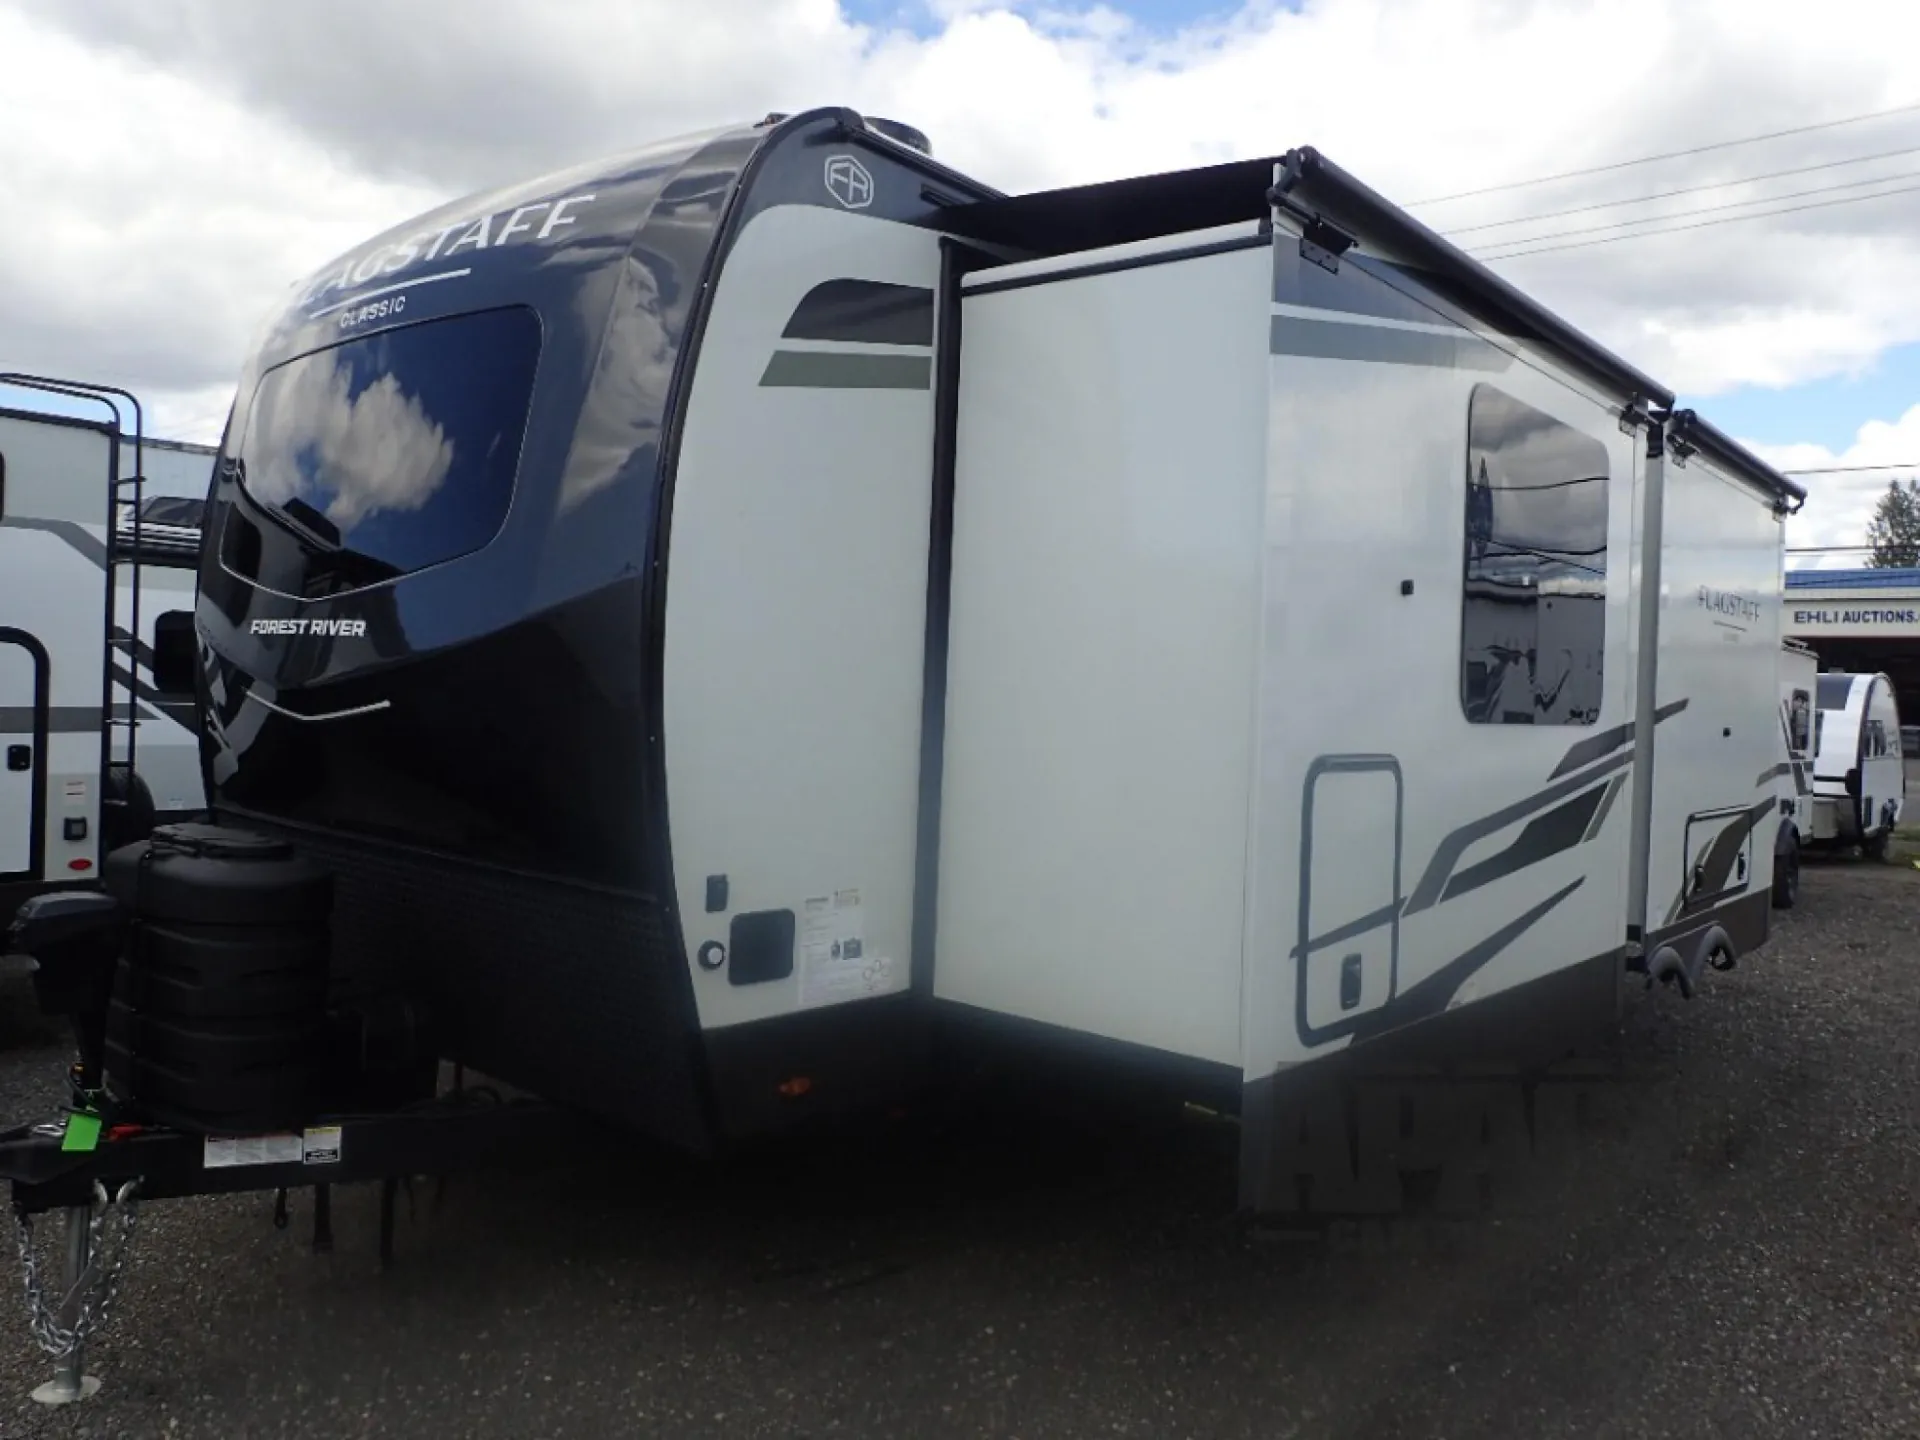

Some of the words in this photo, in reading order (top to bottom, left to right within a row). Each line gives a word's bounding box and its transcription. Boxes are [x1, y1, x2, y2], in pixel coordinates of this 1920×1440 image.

[297, 194, 596, 304] LAGSTAFF
[340, 295, 406, 328] CLASSIC
[250, 619, 309, 635] FOREST
[309, 619, 366, 637] RIVER
[1794, 610, 1838, 624] EHLI
